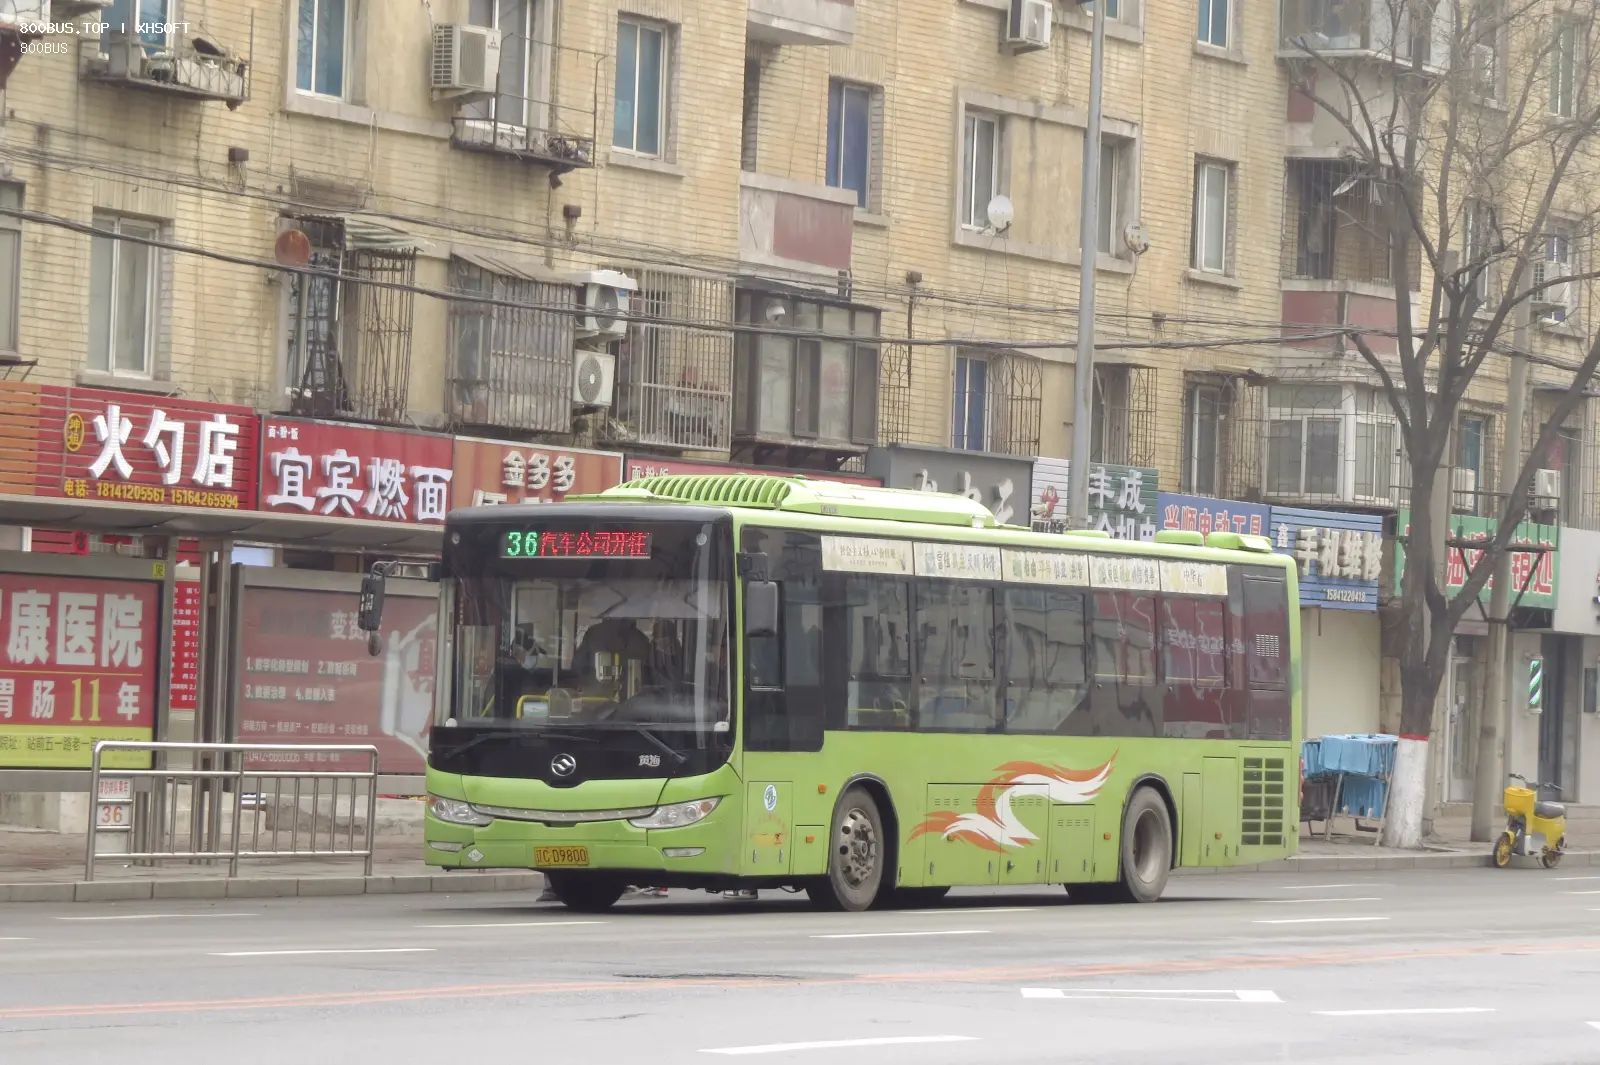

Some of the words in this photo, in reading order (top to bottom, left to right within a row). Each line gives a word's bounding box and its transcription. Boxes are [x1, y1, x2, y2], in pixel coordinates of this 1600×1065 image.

[88, 404, 239, 488] 火勺店
[502, 450, 575, 492] 金多多
[267, 446, 453, 521] 宜宾燃面
[507, 531, 538, 556] 36
[1294, 526, 1383, 581] 手机维修
[0, 589, 143, 668] 康医院
[102, 805, 123, 823] 36
